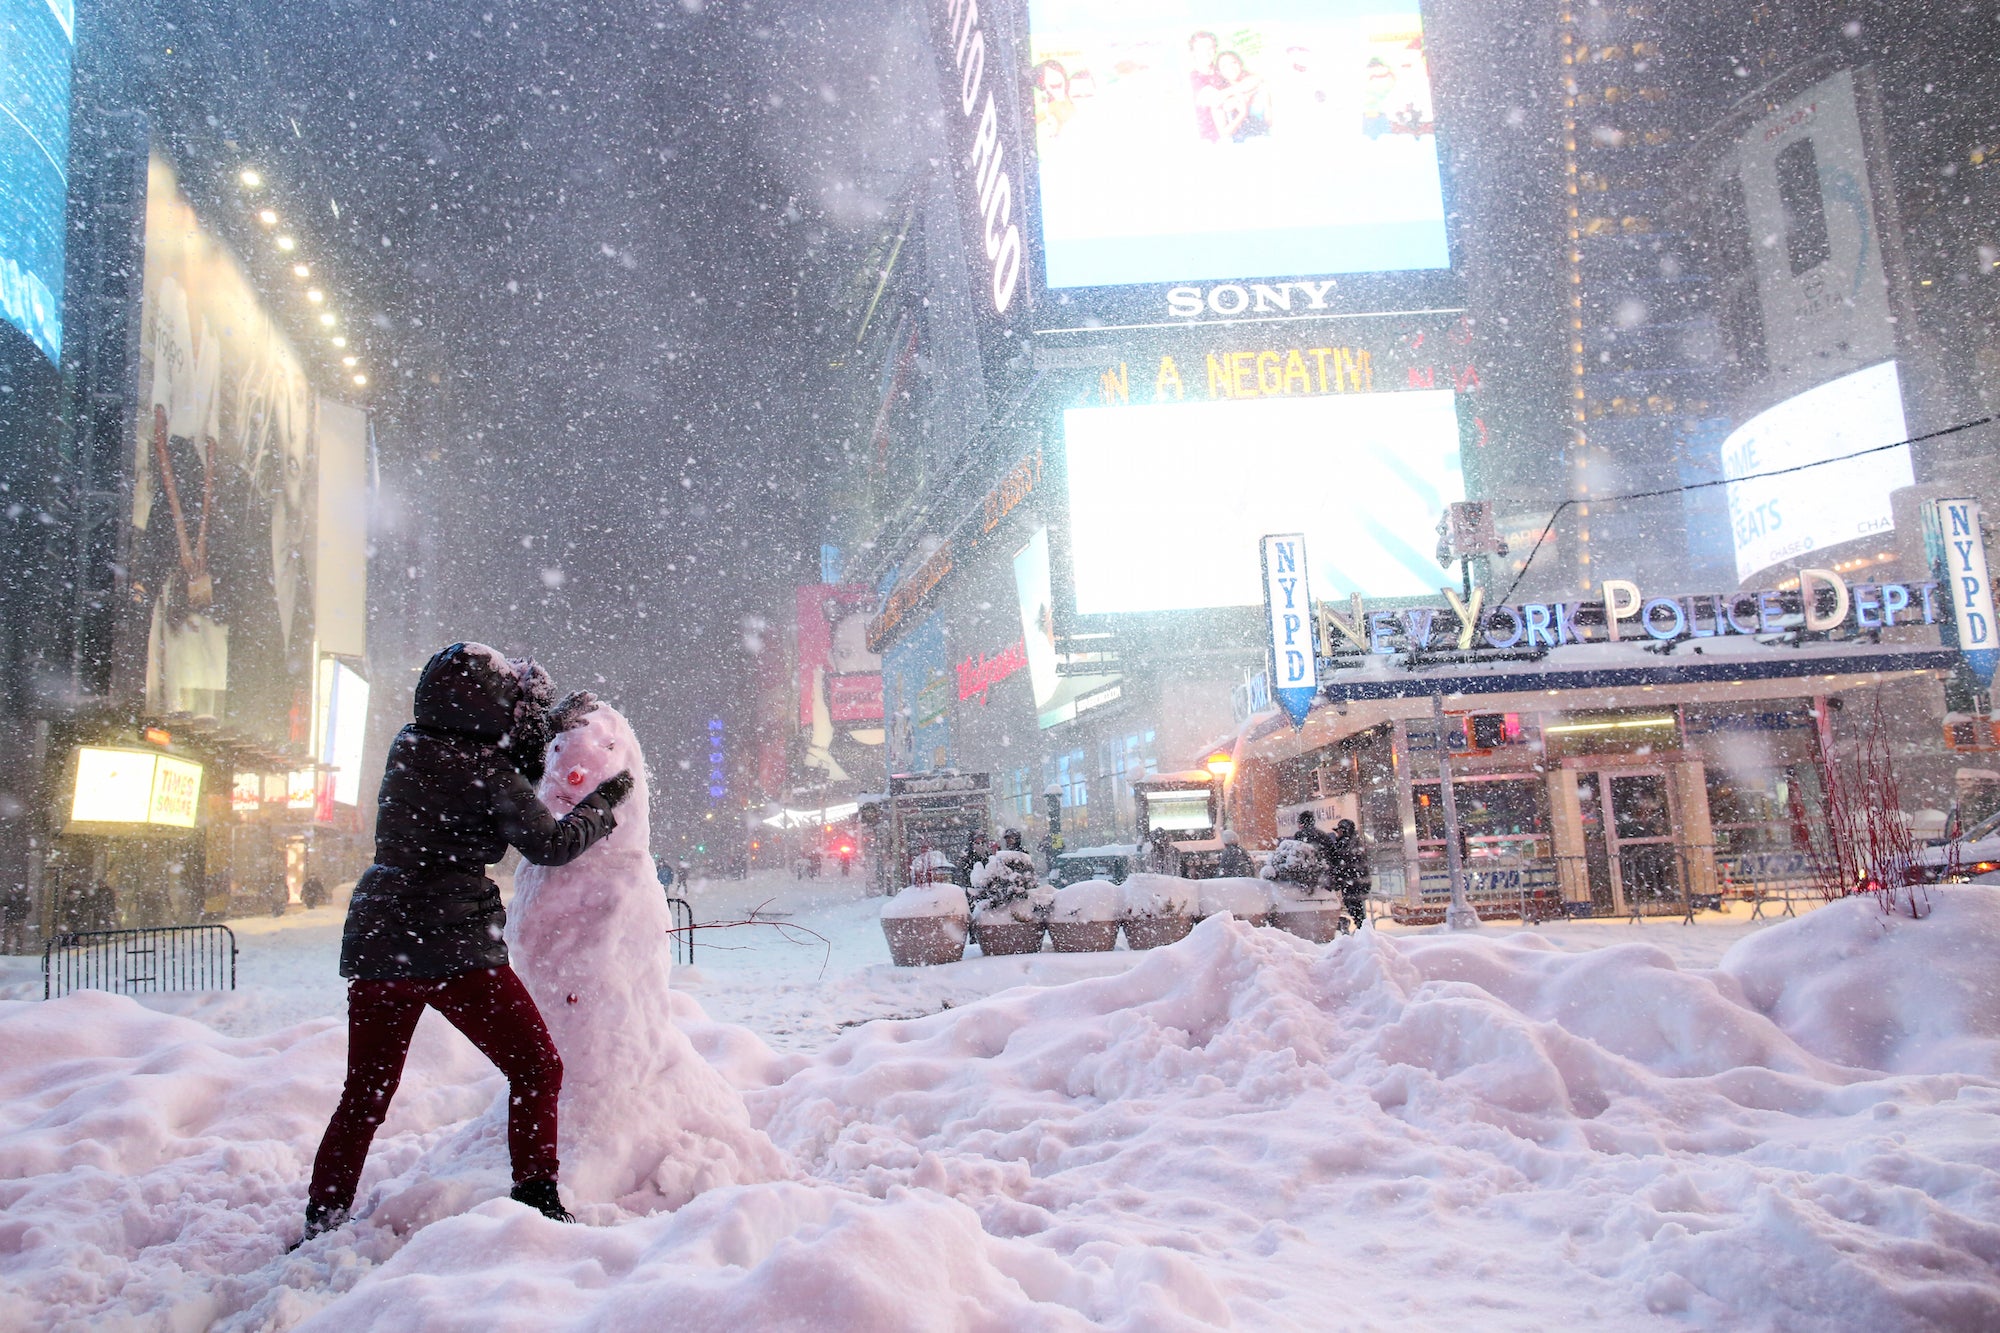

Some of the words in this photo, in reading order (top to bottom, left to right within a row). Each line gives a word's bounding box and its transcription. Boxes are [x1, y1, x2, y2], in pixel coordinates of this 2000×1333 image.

[948, 0, 984, 117] TO
[972, 89, 1021, 314] RICO
[1166, 280, 1337, 317] SONY
[1156, 356, 1184, 400] A
[1857, 515, 1894, 534] CHA
[1948, 505, 1988, 644] NYPD
[1275, 541, 1305, 682] NYPD
[1315, 591, 1433, 657] NEW
[1440, 585, 1586, 650] YORK
[1602, 579, 1786, 640] POLICE
[1800, 568, 1938, 632] DEPT
[161, 768, 195, 798] TIMES
[155, 795, 192, 817] SQUARE
